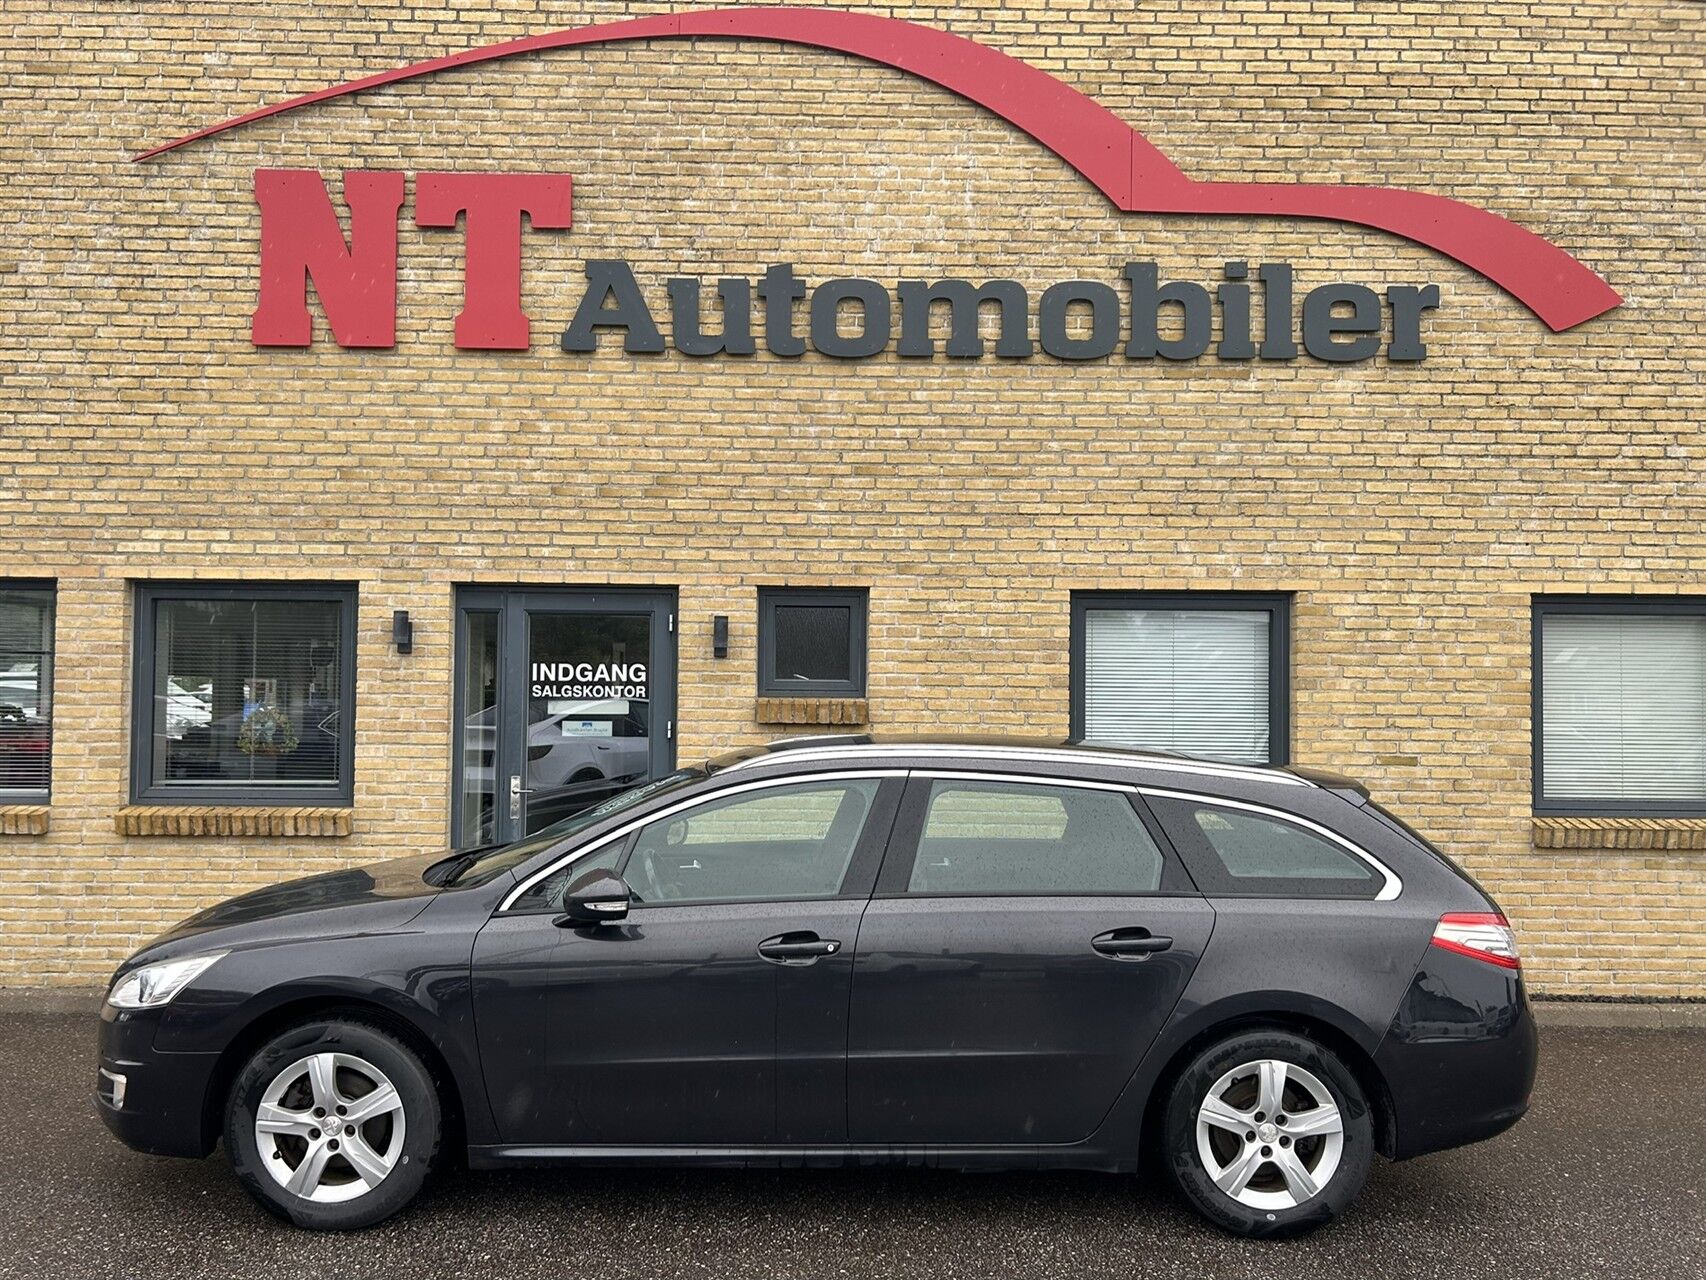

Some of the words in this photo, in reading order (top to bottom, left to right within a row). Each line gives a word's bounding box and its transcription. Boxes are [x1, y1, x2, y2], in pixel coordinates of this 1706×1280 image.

[251, 168, 573, 350] NT
[562, 261, 1440, 363] Automobiler
[531, 662, 647, 683] INDGANG
[531, 684, 647, 698] SALGSKONTOR
